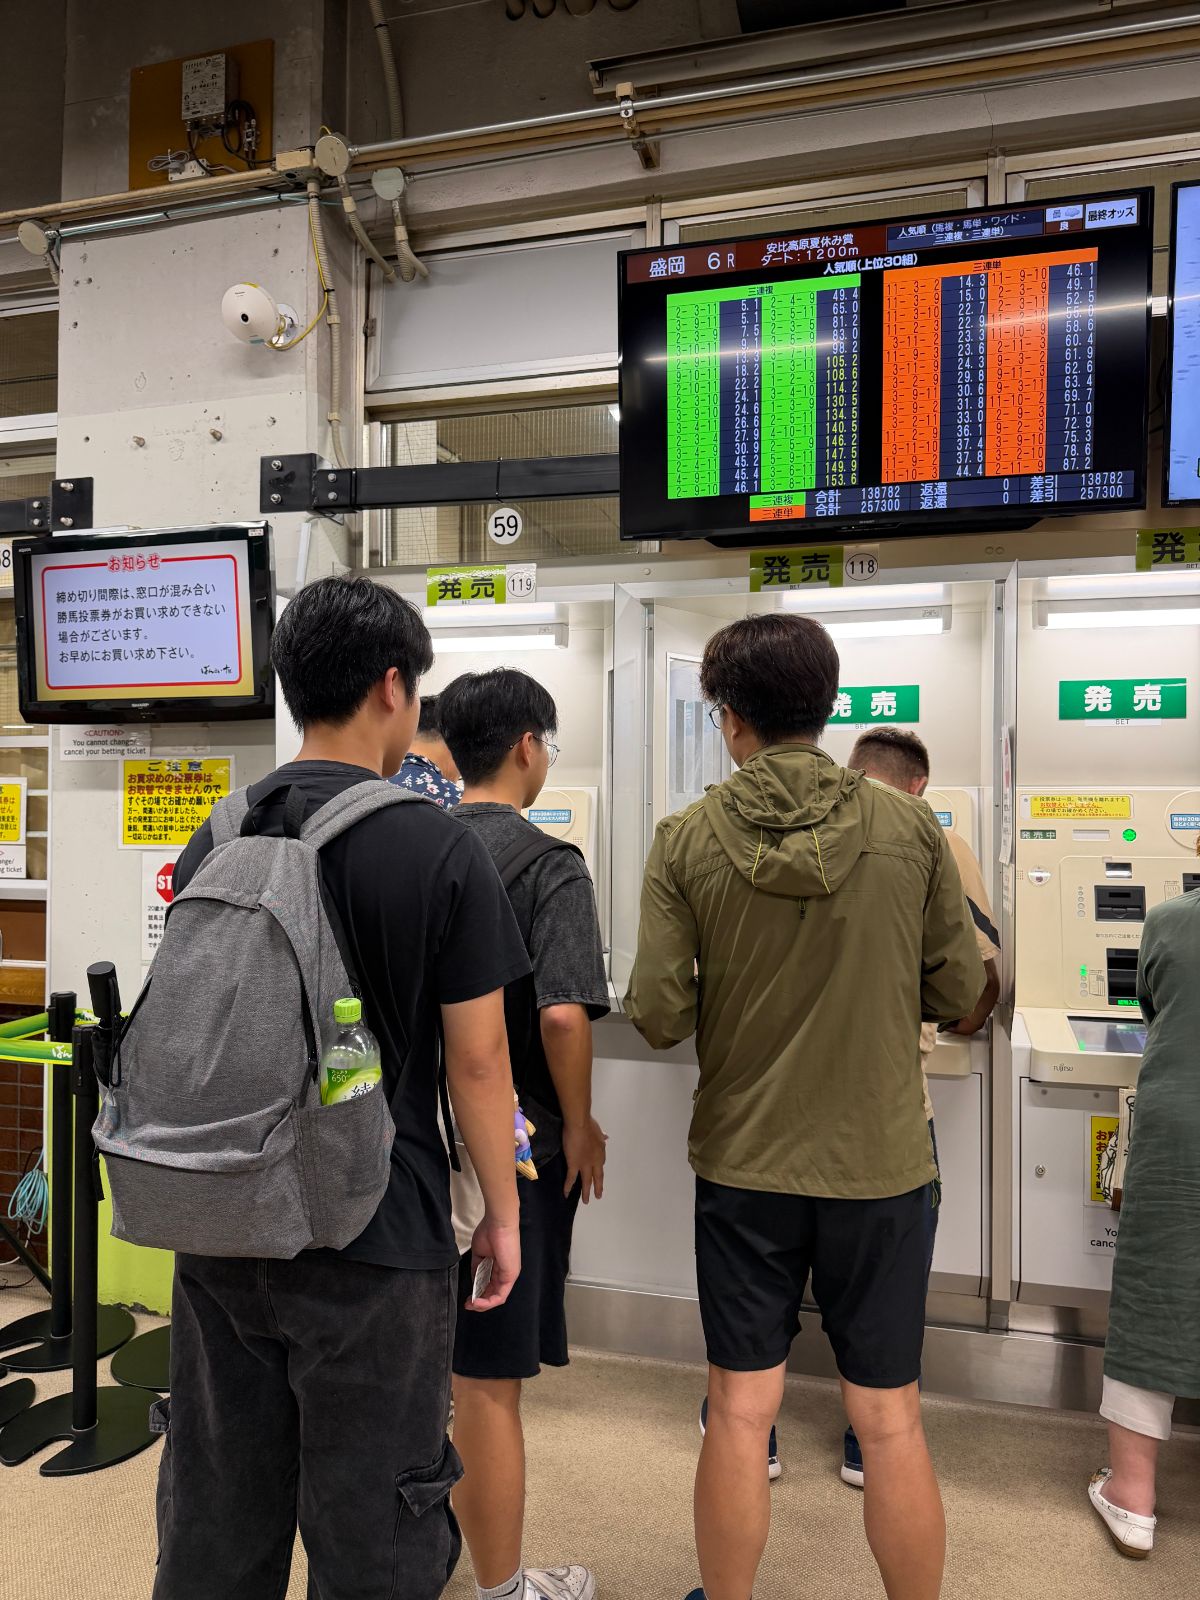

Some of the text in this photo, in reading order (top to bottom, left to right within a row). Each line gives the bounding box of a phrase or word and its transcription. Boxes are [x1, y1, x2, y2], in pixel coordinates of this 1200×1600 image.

[1087, 206, 1135, 222] 最終オッズ
[766, 234, 854, 254] 安比高原夏休み賞
[649, 256, 686, 278] 盛岡
[823, 252, 918, 276] 人気順(上位30組)
[972, 260, 1002, 272] 三連単
[747, 285, 774, 296] 三連複
[762, 471, 1124, 506] 三連複 合計 138782 返還 0 差引 138782
[814, 503, 842, 516] 合計
[860, 498, 900, 514] 257300
[920, 496, 948, 510] 返還
[1003, 492, 1010, 504] 0
[1030, 488, 1058, 504] 差引
[1080, 485, 1124, 500] 257300
[494, 514, 518, 538] 59
[0, 549, 10, 568] 8
[106, 554, 162, 572] お知らせ
[762, 552, 876, 584] 発売 118
[56, 583, 216, 604] 締め切り間際は、窓口が混み合い
[438, 573, 532, 600] 発売 119
[56, 604, 226, 624] 勝馬投票券がお買い求めできない
[58, 628, 149, 644] 場合がございます。
[58, 646, 195, 663] お早めにお買い求め下さい。
[831, 691, 896, 718] 発売
[1084, 682, 1162, 712] 発売
[86, 748, 100, 756] your
[102, 748, 125, 756] betting
[126, 747, 146, 755] ticket
[148, 760, 202, 772] ご注意
[128, 773, 213, 784] お買求めの投票券は
[158, 875, 172, 890] ST
[332, 1074, 346, 1082] 650
[1104, 1228, 1118, 1237] Yo
[1090, 1239, 1116, 1248] canc
